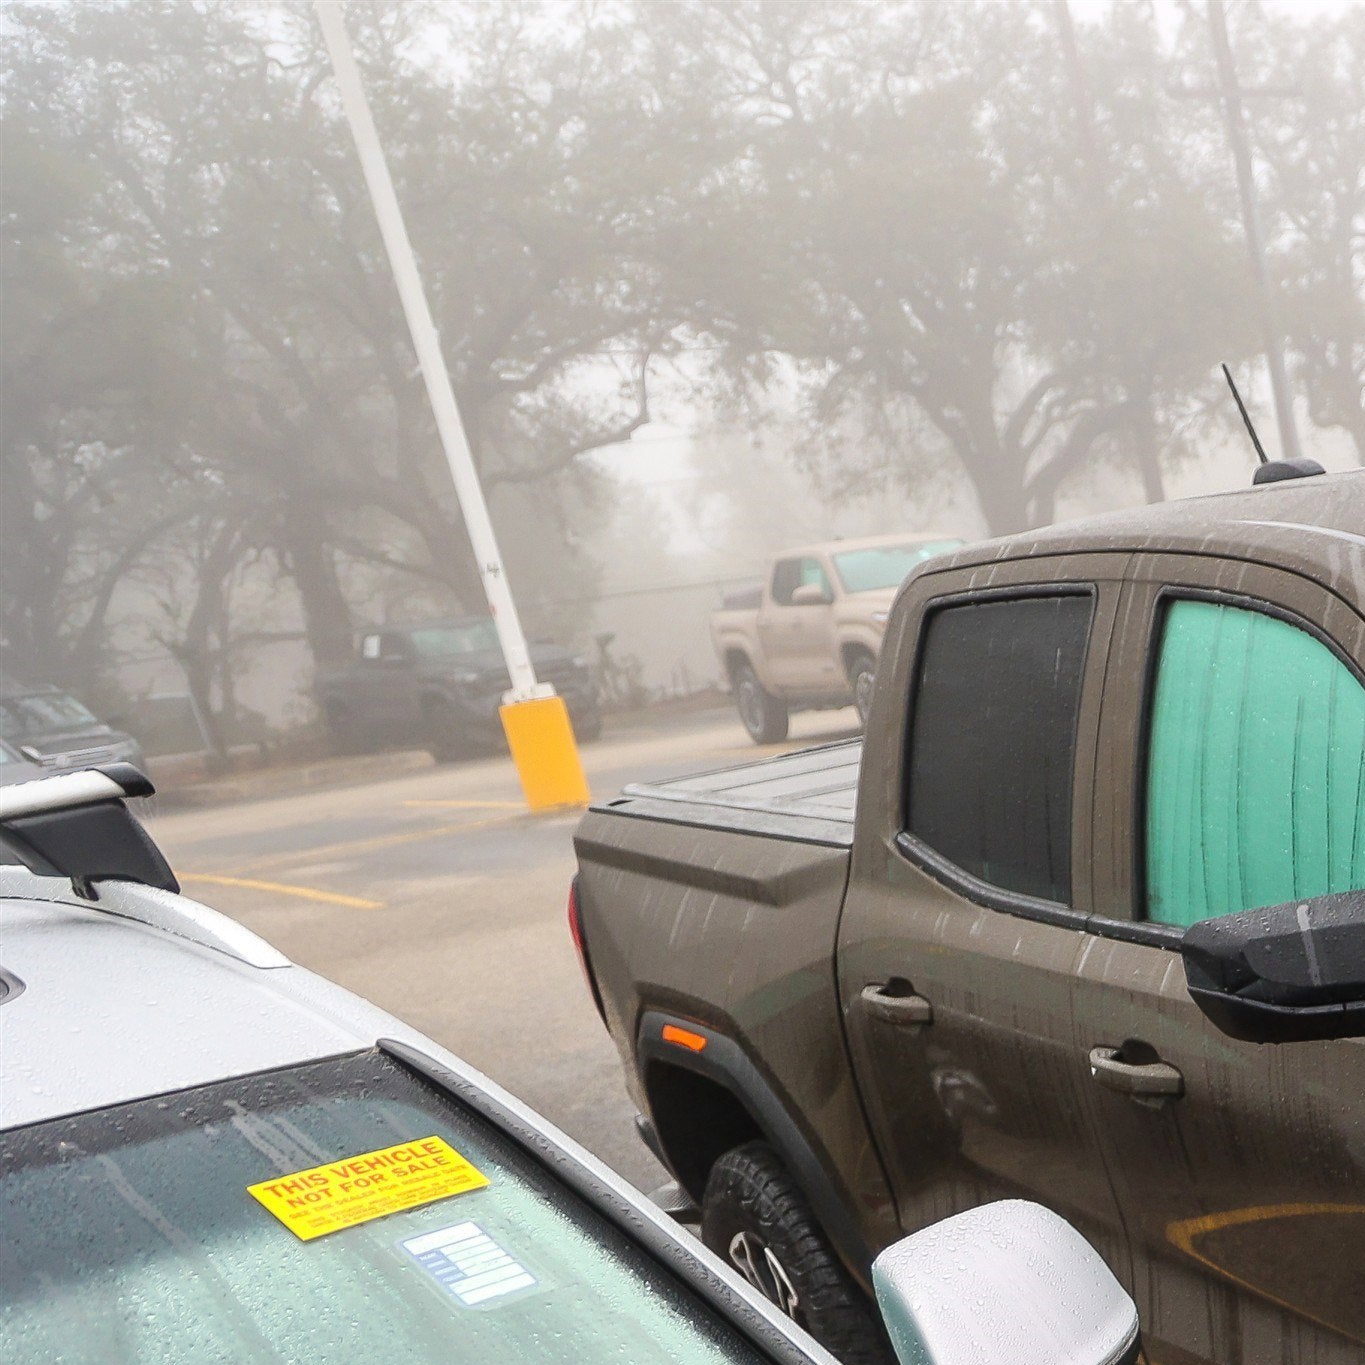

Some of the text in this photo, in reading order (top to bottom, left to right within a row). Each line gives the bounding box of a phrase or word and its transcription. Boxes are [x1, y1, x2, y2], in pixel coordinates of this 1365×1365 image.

[263, 1141, 442, 1197] THIS VEHICLE
[286, 1155, 450, 1208] NOT FOR SALE
